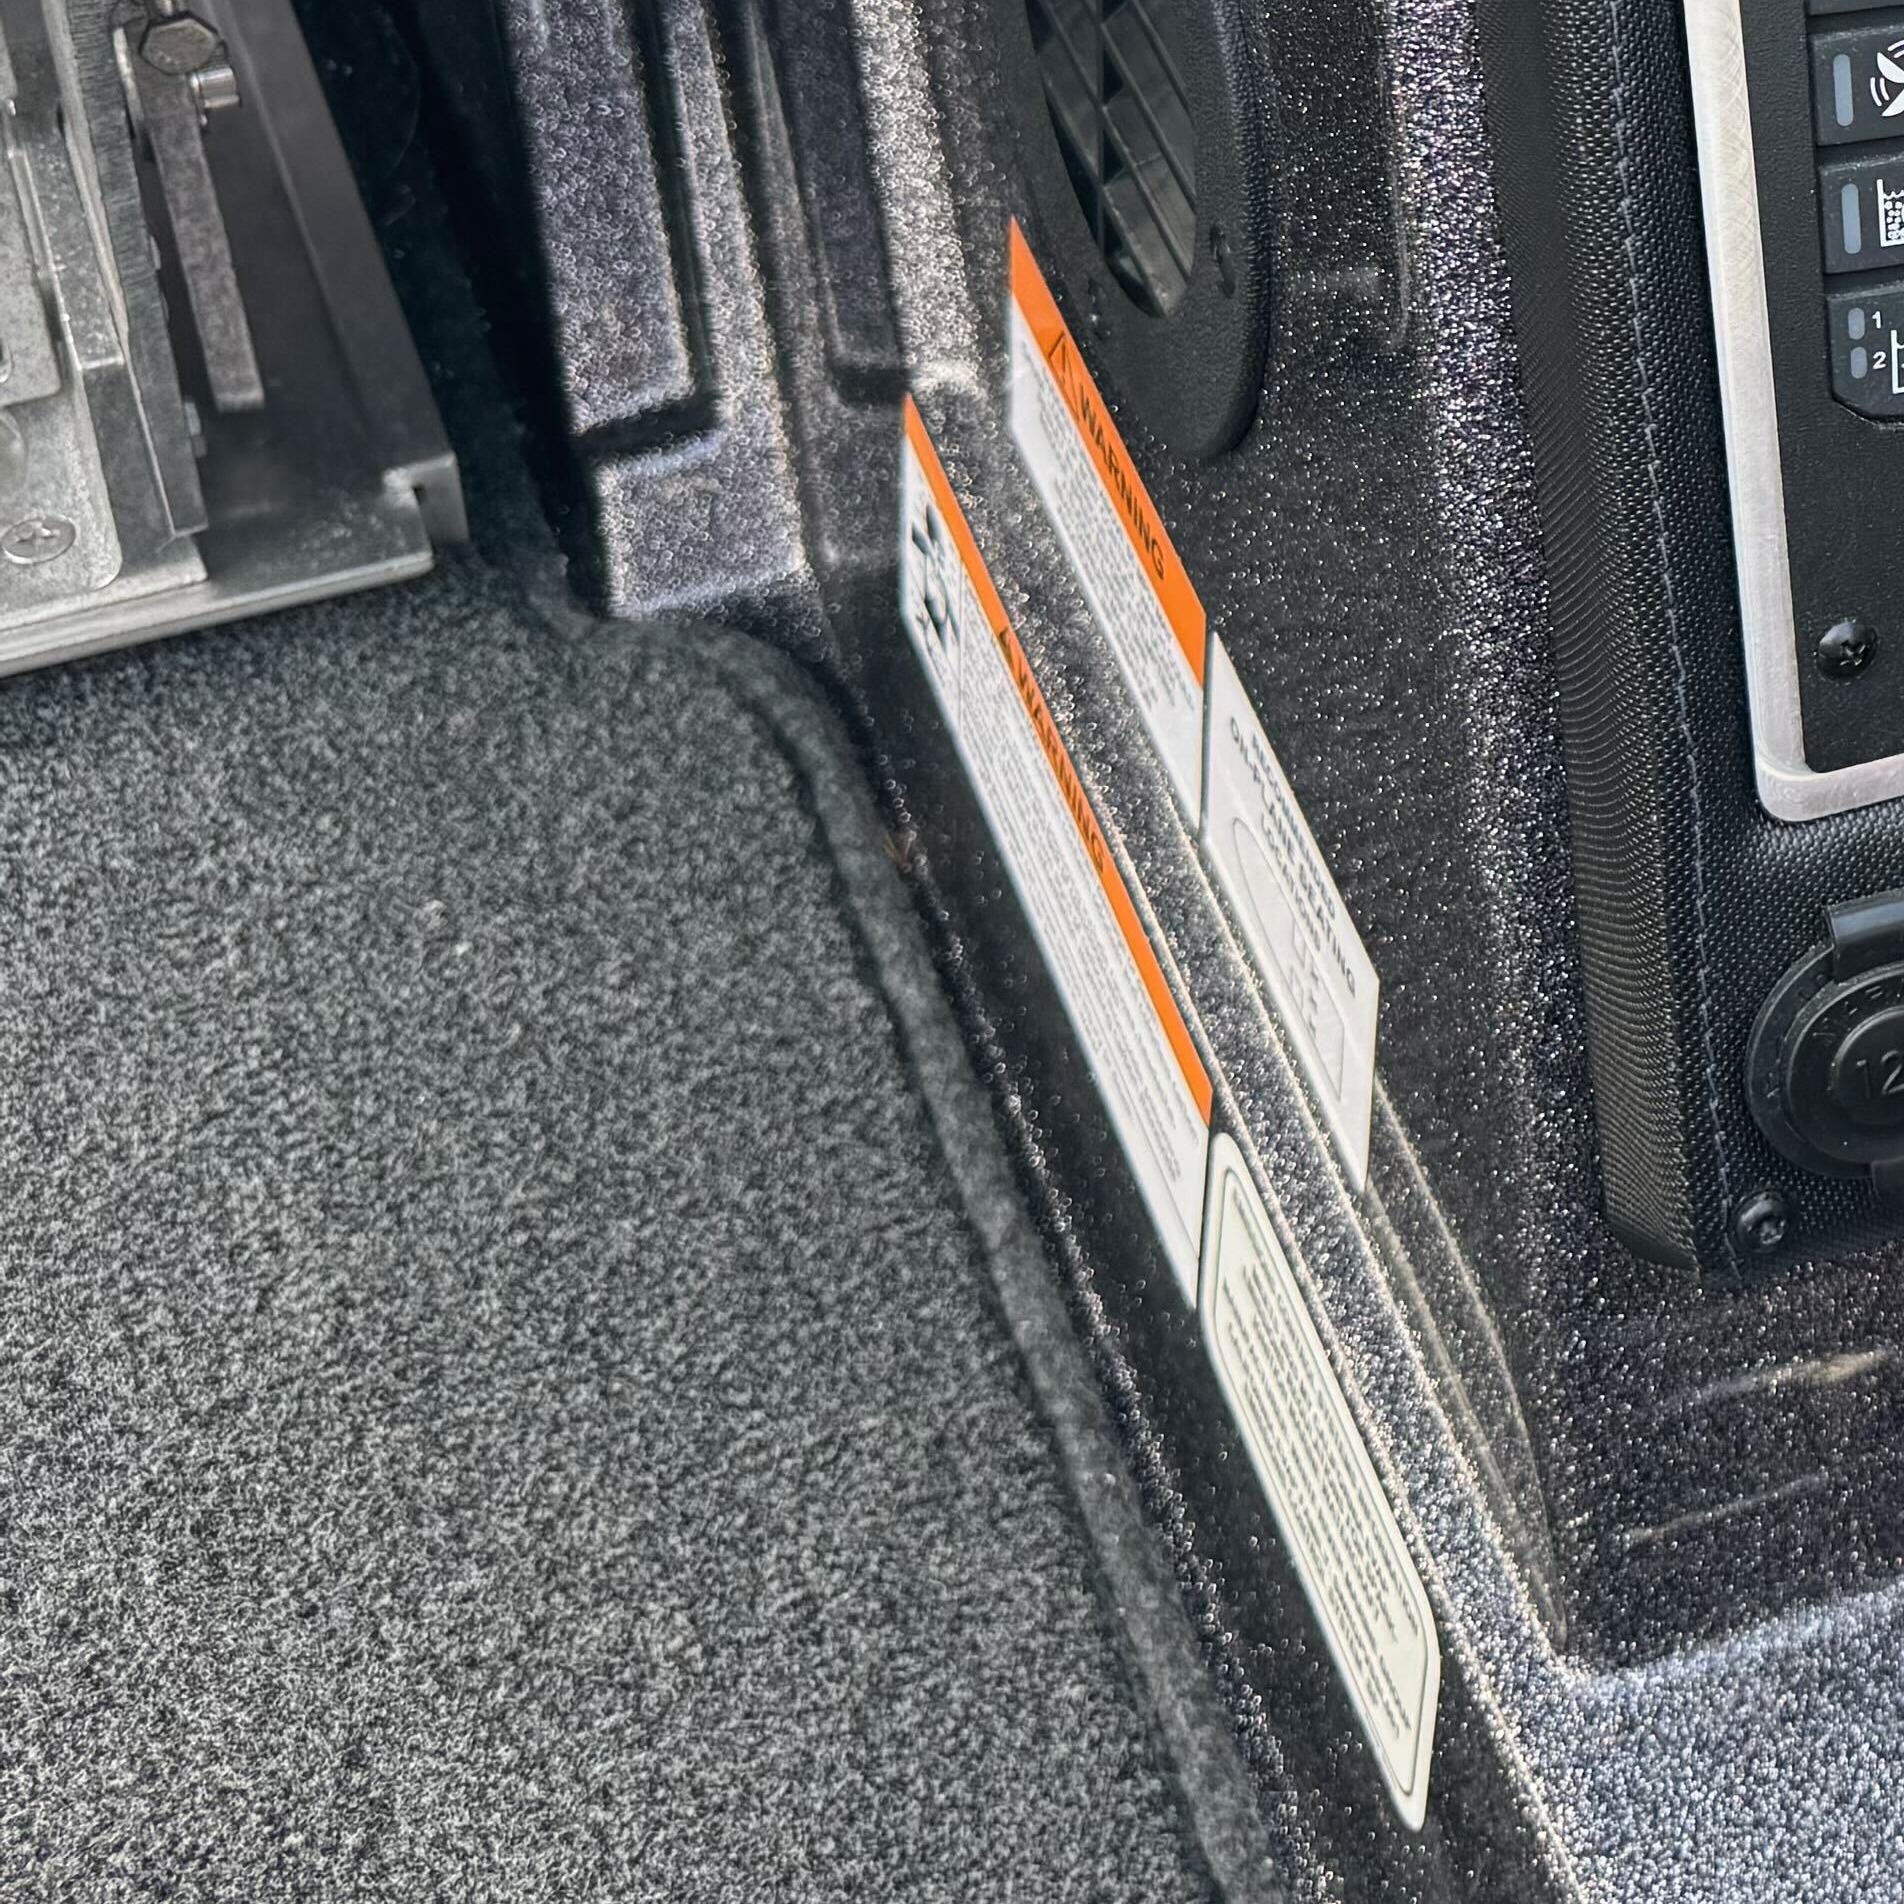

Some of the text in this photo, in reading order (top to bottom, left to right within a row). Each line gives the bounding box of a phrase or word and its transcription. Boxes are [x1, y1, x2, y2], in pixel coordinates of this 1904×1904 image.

[1872, 311, 1882, 329] 1
[1872, 352, 1887, 370] 2
[1080, 382, 1164, 582] WARNING
